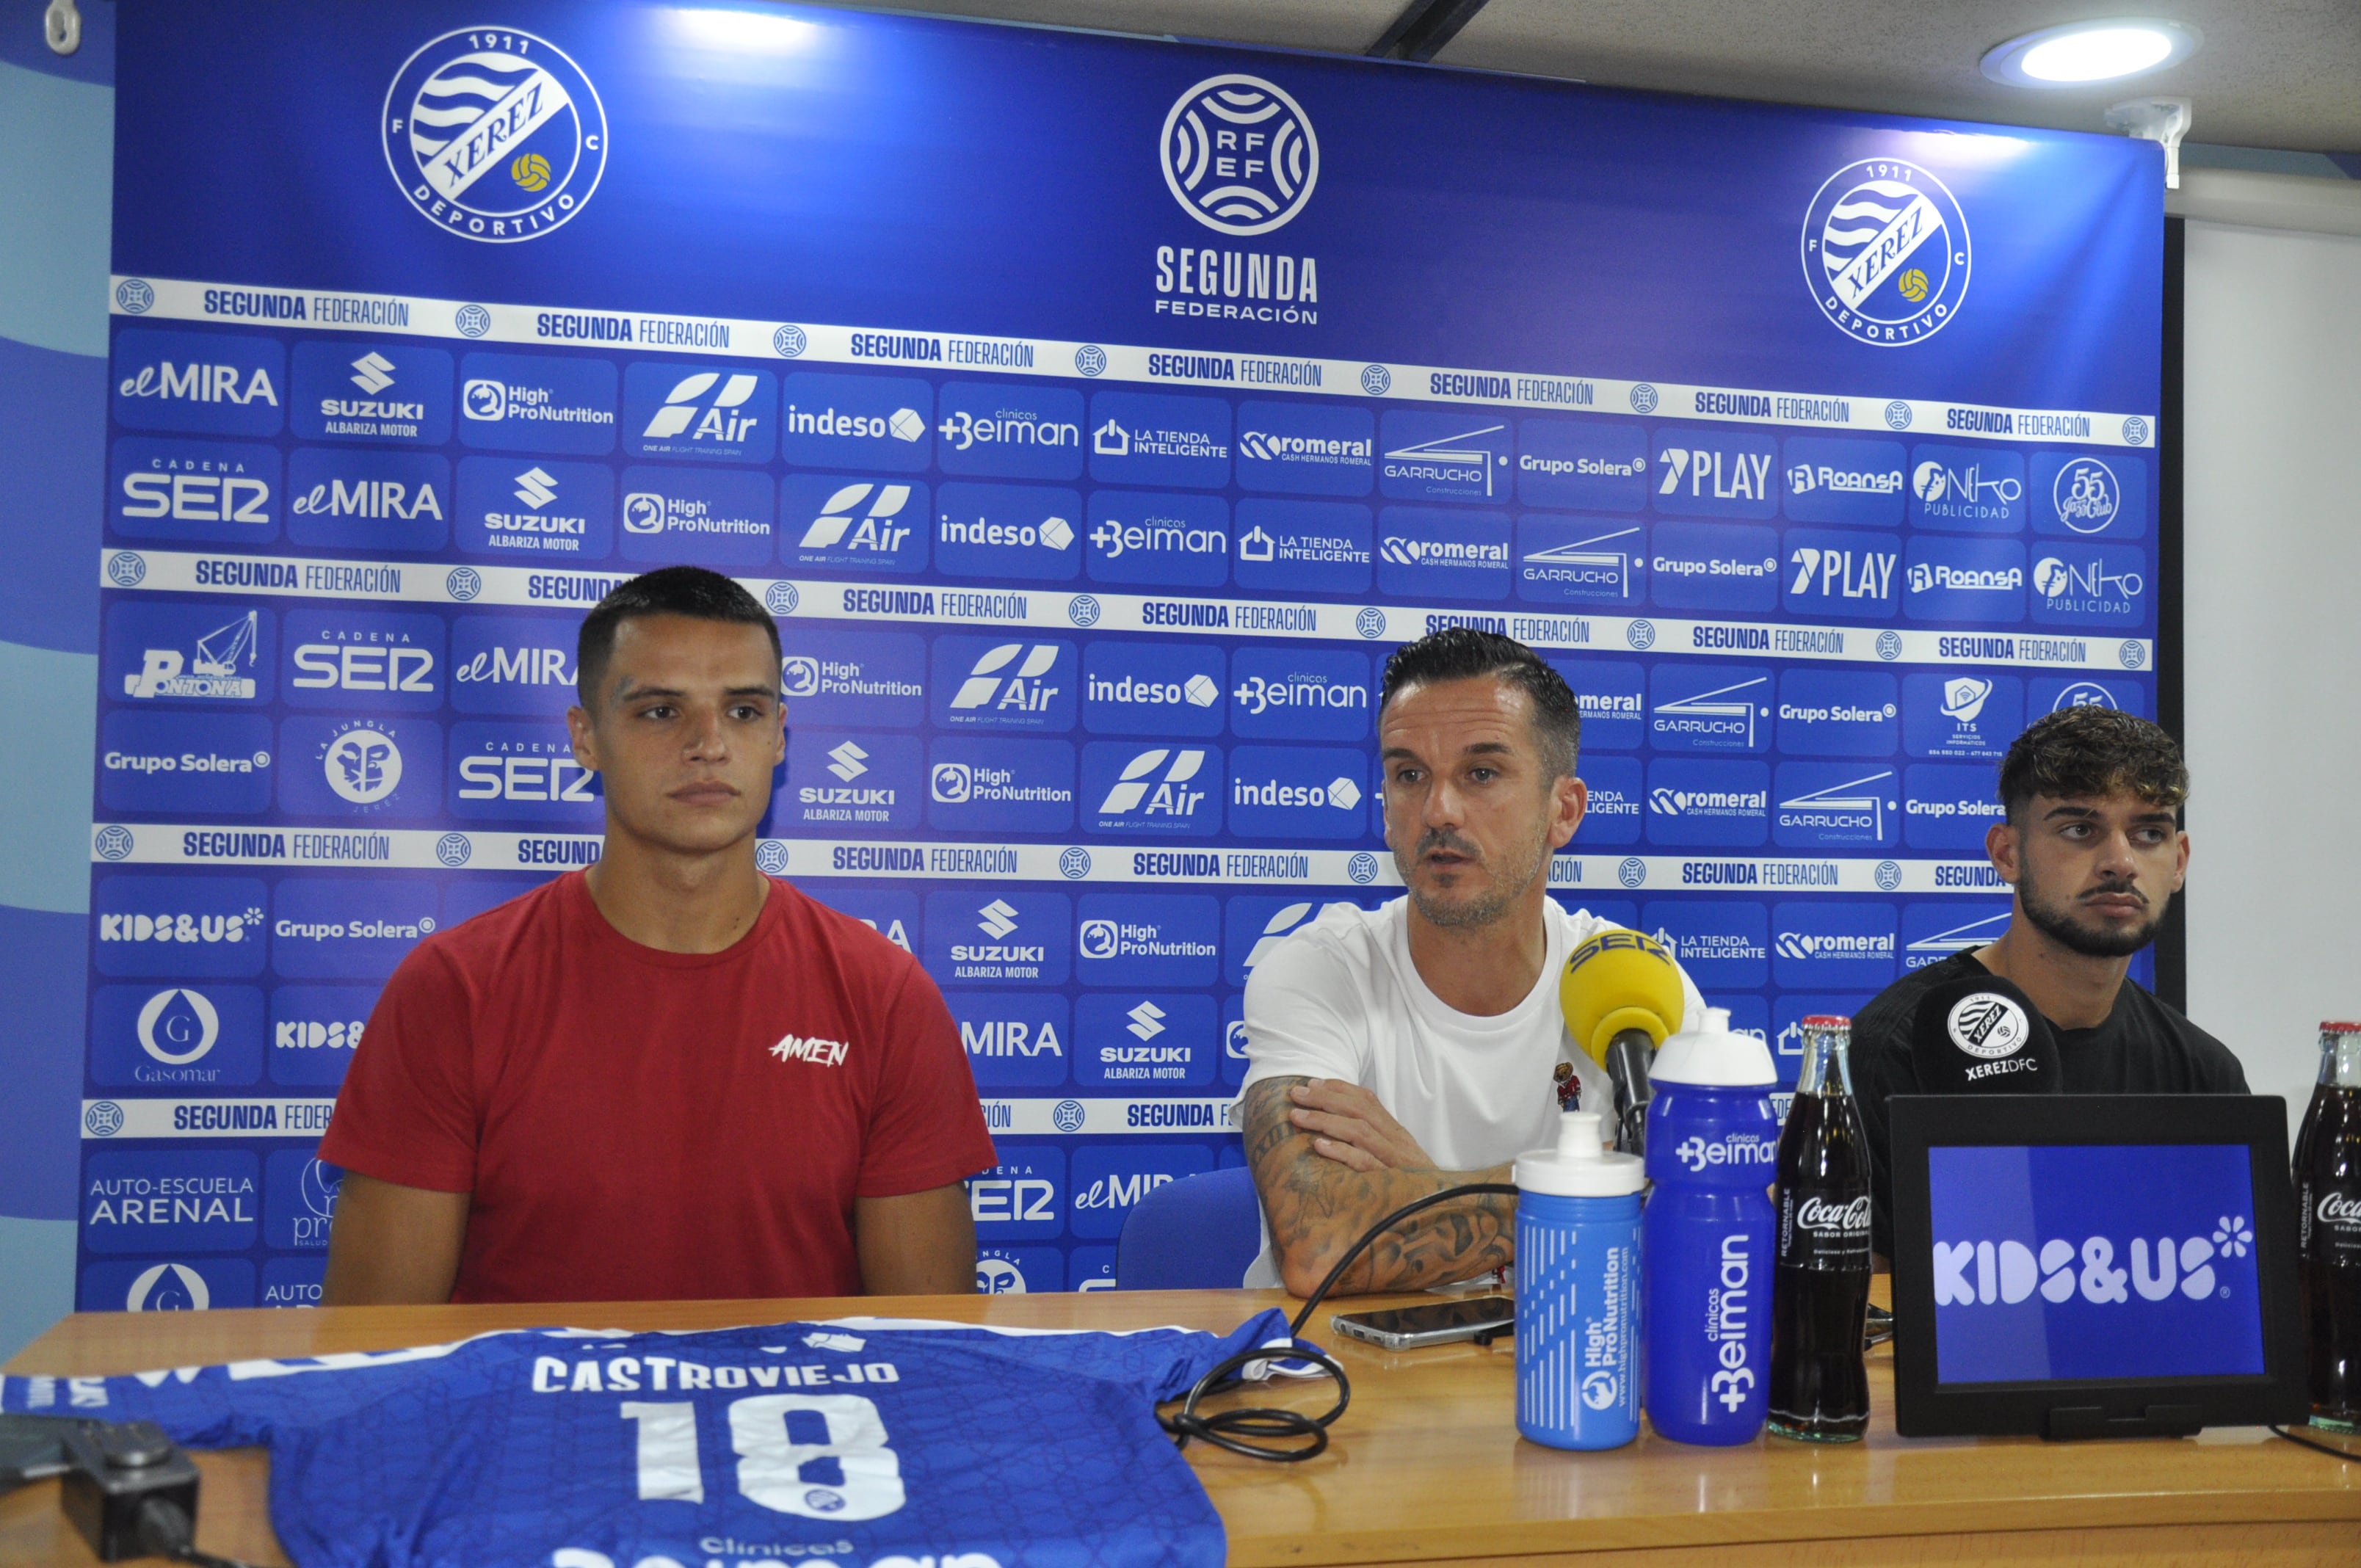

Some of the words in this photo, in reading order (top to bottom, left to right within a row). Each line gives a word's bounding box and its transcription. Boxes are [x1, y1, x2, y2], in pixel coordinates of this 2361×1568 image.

[469, 33, 529, 54] 1911
[392, 118, 403, 134] F
[442, 81, 544, 189] XEREZ
[585, 134, 599, 150] C
[1866, 164, 1912, 183] 1911
[414, 184, 573, 236] DEPORTIVO
[1809, 239, 1818, 252] F
[1848, 206, 1922, 299] XEREZ
[1954, 252, 1965, 266] C
[1156, 245, 1318, 303] SEGUNDA
[204, 289, 307, 320] SEGUNDA
[313, 297, 409, 327] FEDERACIÓN
[1155, 300, 1317, 325] FEDERACIÓN
[1825, 297, 1947, 339] DEPORTIVO
[537, 313, 633, 342] SEGUNDA
[639, 319, 730, 349] FEDERACIÓN
[851, 333, 942, 362] SEGUNDA
[948, 340, 1034, 368] FEDERACIÓN
[1148, 353, 1235, 381] SEGUNDA
[1241, 360, 1321, 387] FEDERACIÓN
[509, 385, 548, 406] High
[1430, 372, 1512, 399] SEGUNDA
[1517, 378, 1593, 405] FEDERACIÓN
[321, 399, 424, 420] SUZUKI
[508, 403, 614, 424] ProNutrition
[1694, 391, 1771, 418] SEGUNDA
[1777, 397, 1849, 423] FEDERACIÓN
[324, 421, 378, 435] ALBARIZA
[380, 424, 418, 438] MOTOR
[692, 407, 758, 442] Air
[788, 404, 886, 438] indeso
[1946, 408, 2013, 434] SEGUNDA
[2017, 413, 2090, 438] FEDERACIÓN
[1134, 429, 1153, 442] LA
[1156, 430, 1211, 445] TIENDA
[1281, 437, 1372, 457] romeral
[642, 444, 659, 452] ONE
[1134, 441, 1227, 458] INTELIGENTE
[152, 458, 244, 473] CADENA
[1281, 453, 1300, 462] CASH
[1301, 454, 1338, 464] HERMANOS
[1340, 456, 1371, 466] ROMERAL
[1519, 454, 1575, 476] Grupo
[1577, 458, 1632, 476] Solera
[1384, 465, 1482, 482] GARRUCHO
[2072, 467, 2105, 501] 55
[122, 472, 269, 523] SER
[1425, 485, 1482, 497] Construcciones
[667, 498, 707, 518] High
[1924, 502, 2010, 520] PUBLICIDAD
[485, 512, 585, 534] SUZUKI
[667, 515, 770, 535] ProNutrition
[941, 515, 1036, 546] indeso
[488, 534, 540, 549] ALBARIZA
[543, 537, 579, 551] MOTOR
[1279, 535, 1298, 548] LA
[1300, 536, 1353, 551] TIENDA
[1421, 542, 1509, 562] romeral
[1279, 548, 1370, 563] INTELIGENTE
[195, 559, 298, 589] SEGUNDA
[305, 565, 401, 594] FEDERACIÓN
[1523, 567, 1619, 584] GARRUCHO
[1653, 556, 1707, 577] Grupo
[1709, 559, 1763, 576] Solera
[843, 589, 935, 615] SEGUNDA
[941, 592, 1027, 620] FEDERACIÓN
[2046, 598, 2130, 614] PUBLICIDAD
[1142, 602, 1229, 628] SEGUNDA
[1235, 605, 1316, 631] FEDERACIÓN
[321, 630, 410, 643] CADENA
[1513, 617, 1589, 643] FEDERACIÓN
[1693, 625, 1770, 650] SEGUNDA
[1774, 628, 1844, 654] FEDERACIÓN
[1939, 636, 2014, 659] SEGUNDA
[2019, 638, 2086, 663] FEDERACIÓN
[293, 644, 434, 692] SER
[822, 661, 860, 680] High
[821, 678, 922, 696] ProNutrition
[1089, 673, 1181, 704] indeso
[1779, 704, 1829, 724] Grupo
[1830, 705, 1883, 722] Solera
[1653, 719, 1746, 734] GARRUCHO
[1956, 722, 1977, 733] ITS
[316, 743, 328, 760] LA
[333, 720, 396, 738] JUNGLA
[104, 751, 177, 774] Grupo
[180, 753, 253, 773] Solera
[458, 755, 595, 802] SER
[973, 768, 1011, 787] High
[799, 787, 895, 805] SUZUKI
[1234, 777, 1324, 807] indeso
[1687, 790, 1766, 810] romeral
[802, 808, 852, 821] ALBARIZA
[855, 809, 890, 822] MOTOR
[1905, 799, 1956, 819] Grupo
[1779, 814, 1873, 828] GARRUCHO
[183, 831, 286, 858] SEGUNDA
[293, 832, 390, 860] FEDERACIÓN
[833, 846, 925, 871] SEGUNDA
[931, 846, 1018, 874] FEDERACIÓN
[1133, 852, 1221, 876] SEGUNDA
[1226, 852, 1308, 879] FEDERACIÓN
[1682, 862, 1758, 885] SEGUNDA
[1763, 861, 1838, 885] FEDERACIÓN
[100, 913, 244, 943] KIDS&US
[275, 920, 344, 942] Grupo
[348, 920, 418, 939] Solera
[1120, 924, 1157, 943] High
[1680, 935, 1697, 947] LA
[1700, 935, 1750, 947] TIENDA
[1813, 932, 1895, 950] romeral
[951, 945, 1044, 962] SUZUKI
[1569, 933, 1670, 975] SER
[1680, 947, 1766, 959] INTELIGENTE
[954, 966, 1003, 978] ALBARIZA
[1004, 966, 1039, 979] MOTOR
[166, 1016, 190, 1042] G
[1973, 1005, 2001, 1042] XEREZ
[769, 1034, 849, 1067] AMEN
[1100, 1047, 1191, 1063] SUZUKI
[1968, 1037, 2021, 1055] DEPORTIVO
[134, 1067, 220, 1082] Gasomar
[1103, 1067, 1150, 1079] ALBARIZA
[1153, 1067, 1186, 1079] MOTOR
[1965, 1058, 2038, 1081] XEREZDFC
[173, 1105, 278, 1130] SEGUNDA
[1127, 1103, 1214, 1127] SEGUNDA
[90, 1177, 254, 1196] AUTO-ESCUELA
[90, 1197, 254, 1225] ARENAL
[1780, 1188, 1790, 1257] RETORNABLE
[1813, 1230, 1841, 1238] SABOR
[1932, 1236, 2216, 1307] KIDS&US
[1584, 1322, 1605, 1367] High
[532, 1356, 899, 1393] CASTROVIEJO
[620, 1393, 906, 1522] 18
